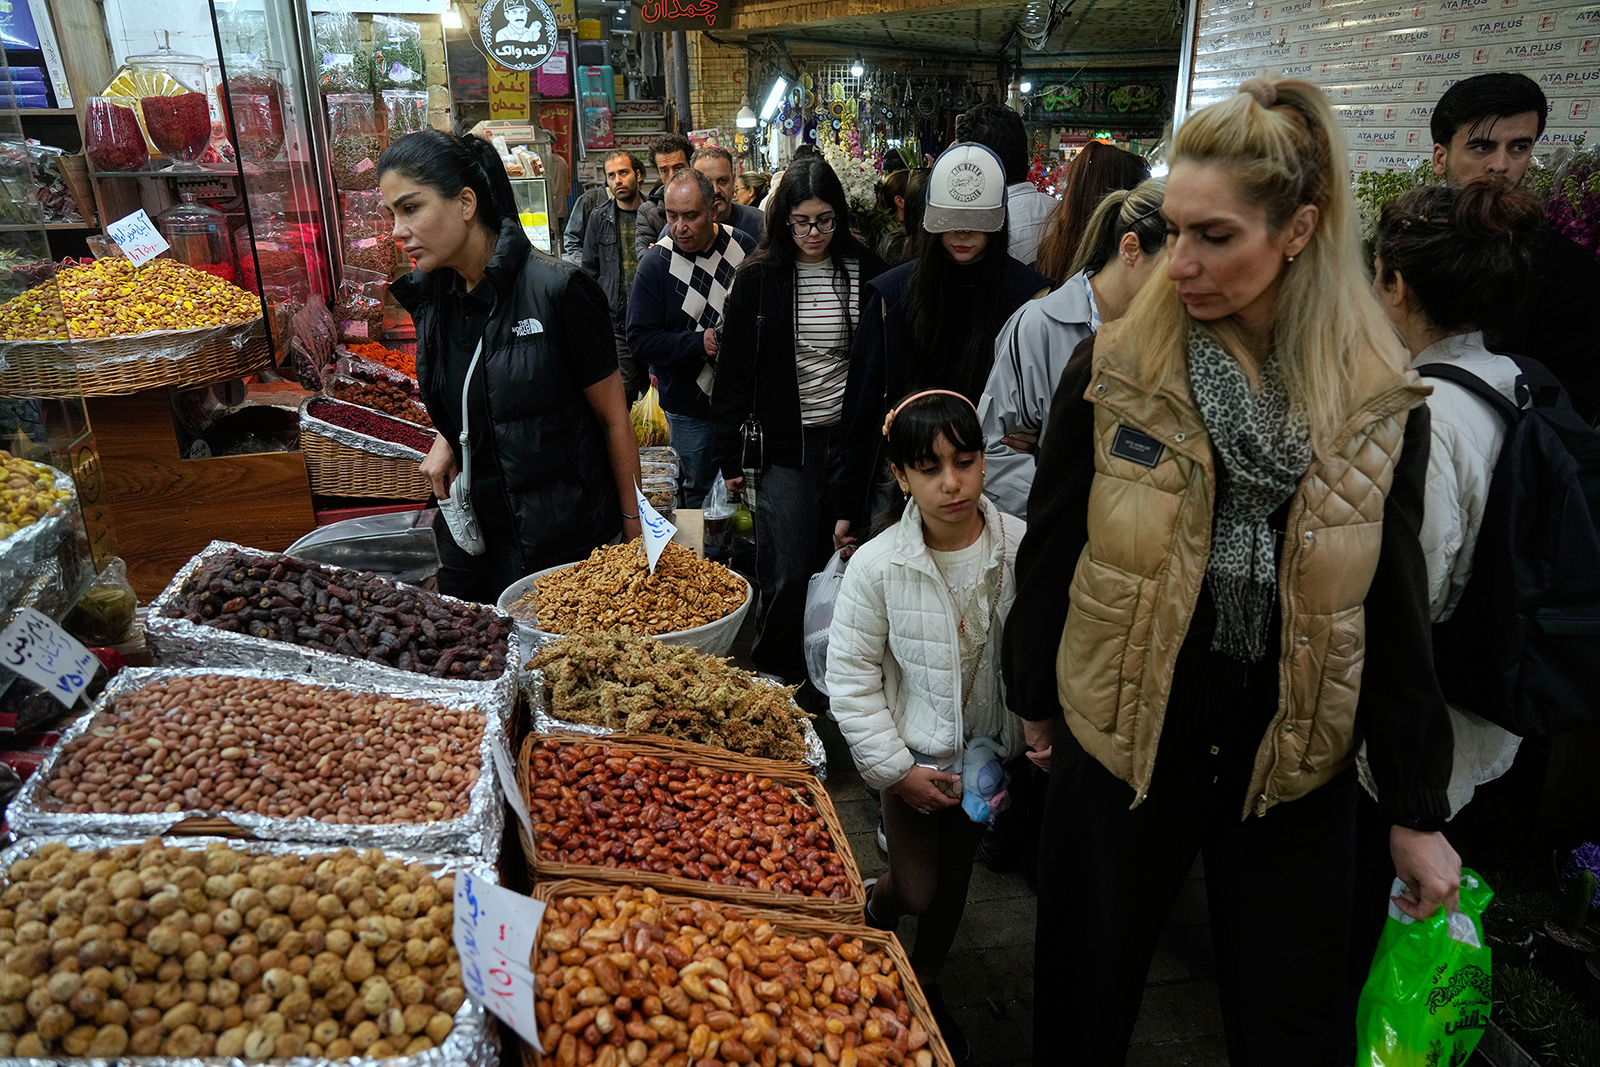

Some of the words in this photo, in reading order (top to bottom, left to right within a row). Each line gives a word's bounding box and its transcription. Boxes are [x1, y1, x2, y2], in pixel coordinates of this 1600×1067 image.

[642, 0, 718, 26] چمدان
[1471, 24, 1490, 32] ATA
[1494, 20, 1522, 29] PLUS
[1405, 32, 1428, 40] PLUS
[495, 44, 522, 59] والک
[524, 44, 547, 56] لقمه
[1506, 46, 1527, 54] ATA
[1530, 43, 1562, 53] PLUS
[1435, 52, 1460, 60] PLUS
[1566, 72, 1599, 80] PLUS
[492, 81, 526, 94] کفش
[492, 99, 526, 116] چمدان
